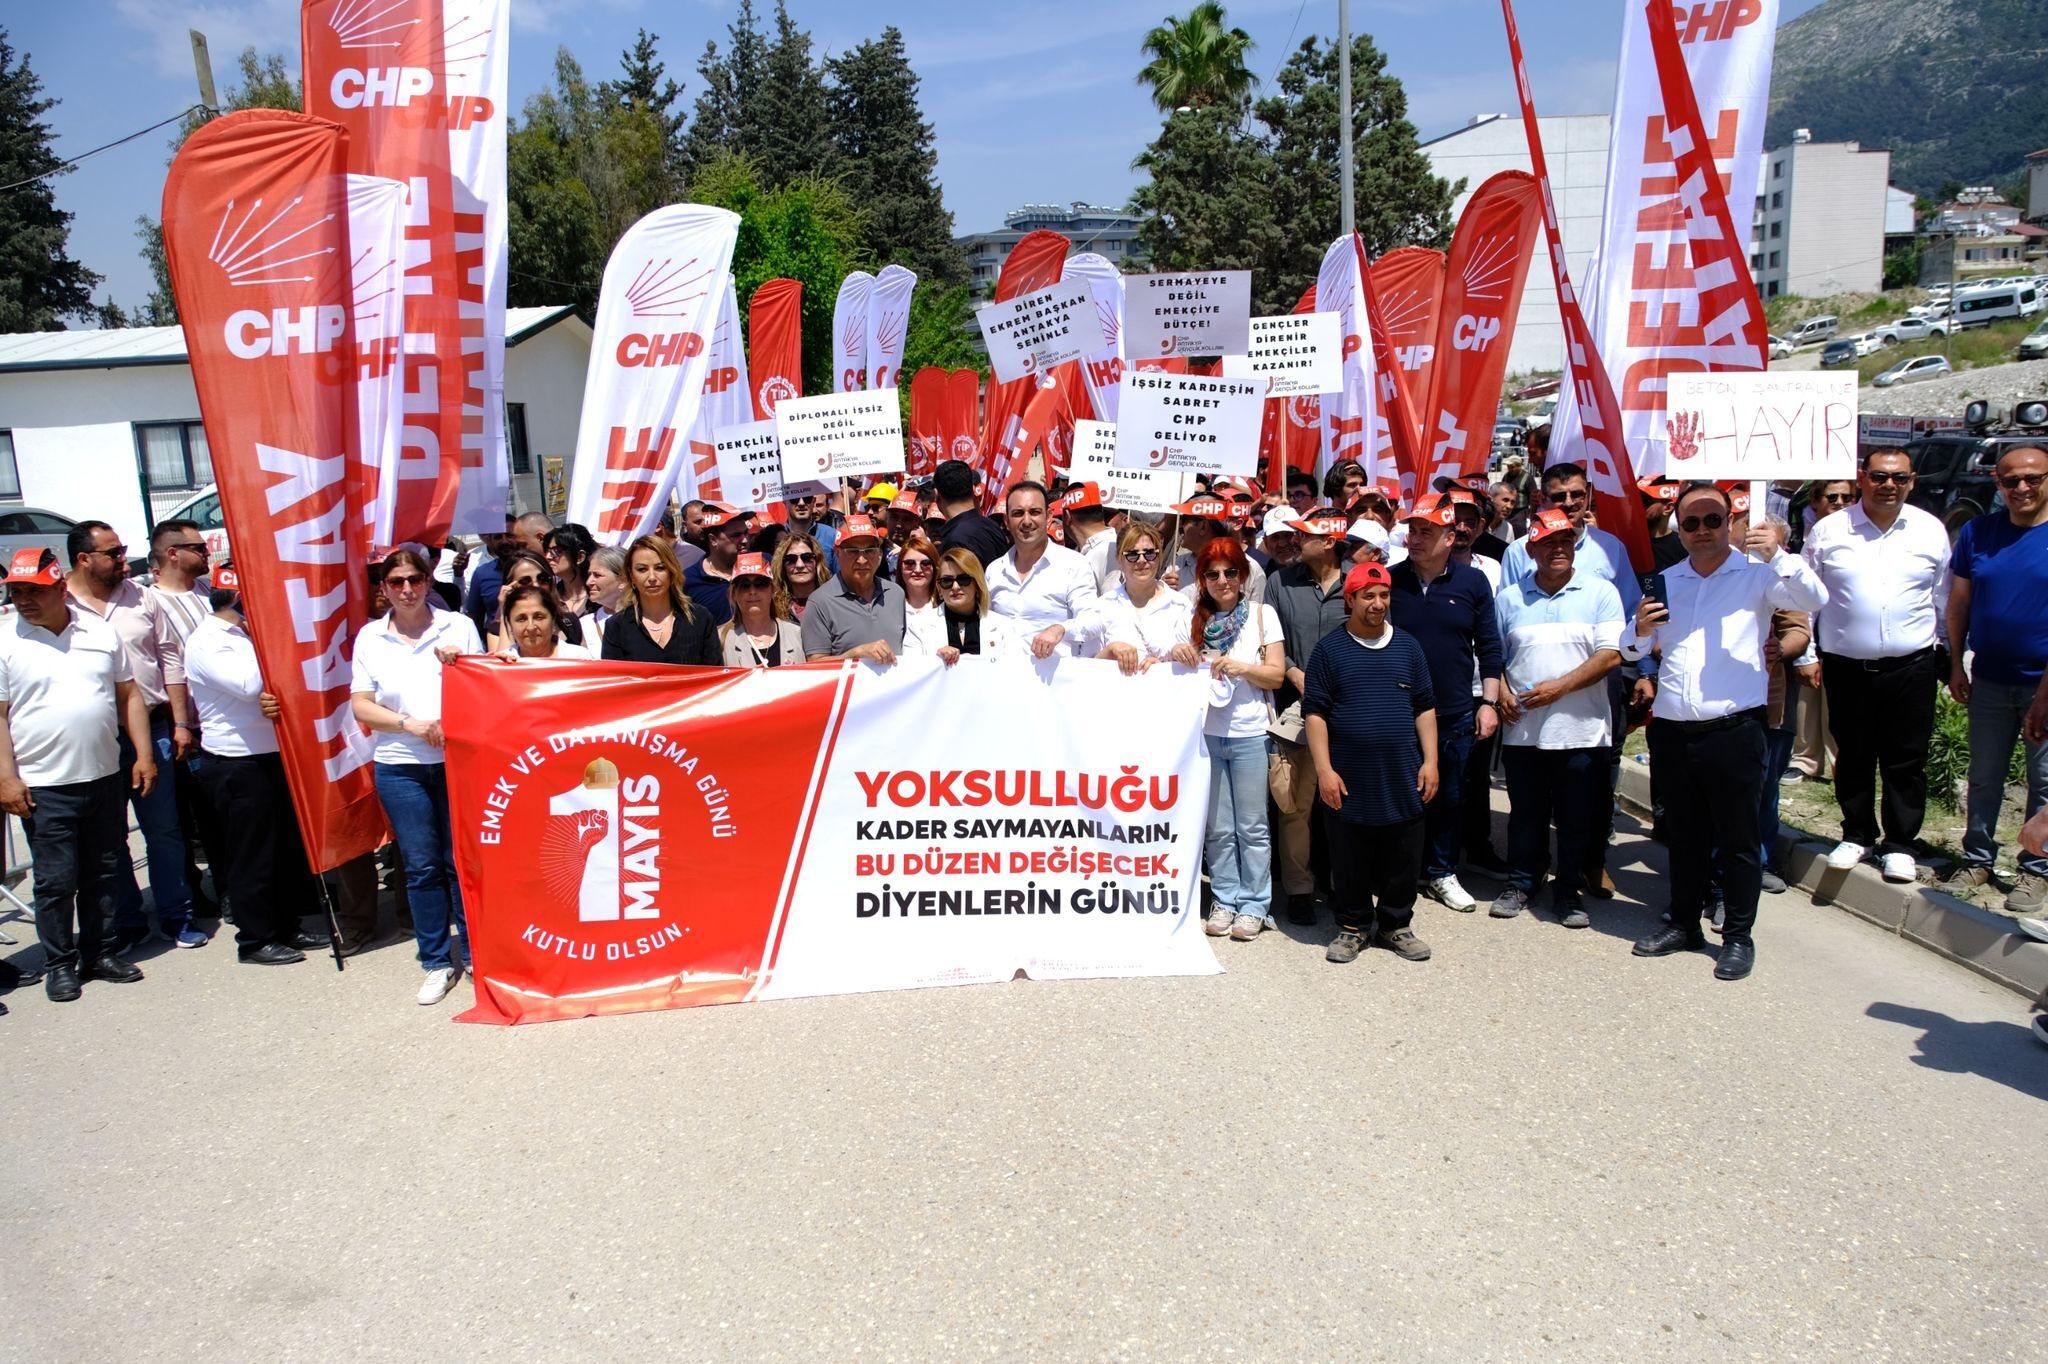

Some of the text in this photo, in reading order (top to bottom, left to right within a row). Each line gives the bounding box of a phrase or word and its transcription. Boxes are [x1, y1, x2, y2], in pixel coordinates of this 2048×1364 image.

[331, 67, 433, 109] CHP
[1150, 277, 1227, 287] SERMAYEYE
[1169, 291, 1206, 300] DEĞİL
[1015, 294, 1053, 312] DİREN
[1155, 304, 1220, 316] EMEKÇİYE
[990, 295, 1086, 334] EKREM BAŞKAN
[224, 304, 345, 359] CHP
[1013, 314, 1070, 339] ANTAKYA
[1164, 320, 1210, 330] BÜTÇE!
[1253, 320, 1309, 330] GENÇLER
[1017, 326, 1069, 350] SENİNLE
[1256, 332, 1307, 343] DİRENİR
[616, 332, 704, 367] CHP
[1248, 346, 1317, 358] EMEKÇİLER
[1394, 345, 1434, 370] HP
[1253, 360, 1312, 371] KAZANIR!
[703, 367, 739, 395] HP
[1132, 376, 1254, 396] İŞSİZ KARDEŞİM
[1686, 381, 1737, 395] BETON
[770, 386, 788, 399] TİP
[1163, 397, 1220, 408] SABRET
[789, 404, 883, 421] DİPLOMALI İŞSİZ
[1173, 414, 1206, 425] CHP
[823, 419, 855, 429] DEĞİL
[785, 432, 845, 446] GÜVENCELİ
[1154, 431, 1217, 443] GELİYOR
[1701, 402, 1853, 464] HAYIR
[718, 435, 772, 450] GENÇLİK
[1168, 460, 1195, 468] GENÇLİK
[1108, 470, 1151, 481] GELDİK
[1468, 480, 1489, 491] CH
[1659, 487, 1679, 497] CH
[1192, 502, 1224, 515] CHP
[1232, 505, 1250, 516] CH
[1441, 507, 1455, 523] CH
[704, 514, 721, 524] HP
[1318, 520, 1347, 532] CHP
[13, 566, 37, 574] CHP
[255, 442, 374, 782] HATAY
[480, 776, 518, 845] EMEK
[510, 745, 546, 775] VE
[696, 774, 737, 838] GÜNÜ
[855, 765, 1179, 812] YOKSULLUĞU
[856, 819, 1178, 844] KADER SAYMAYANLARIN,
[622, 774, 660, 920] MAYIS
[856, 846, 1179, 880] BU DÜZEN DEĞİŞECEK,
[856, 881, 1180, 918] DİYENLERİN GÜNÜ!
[522, 923, 691, 960] KUTLU OLSUN.
